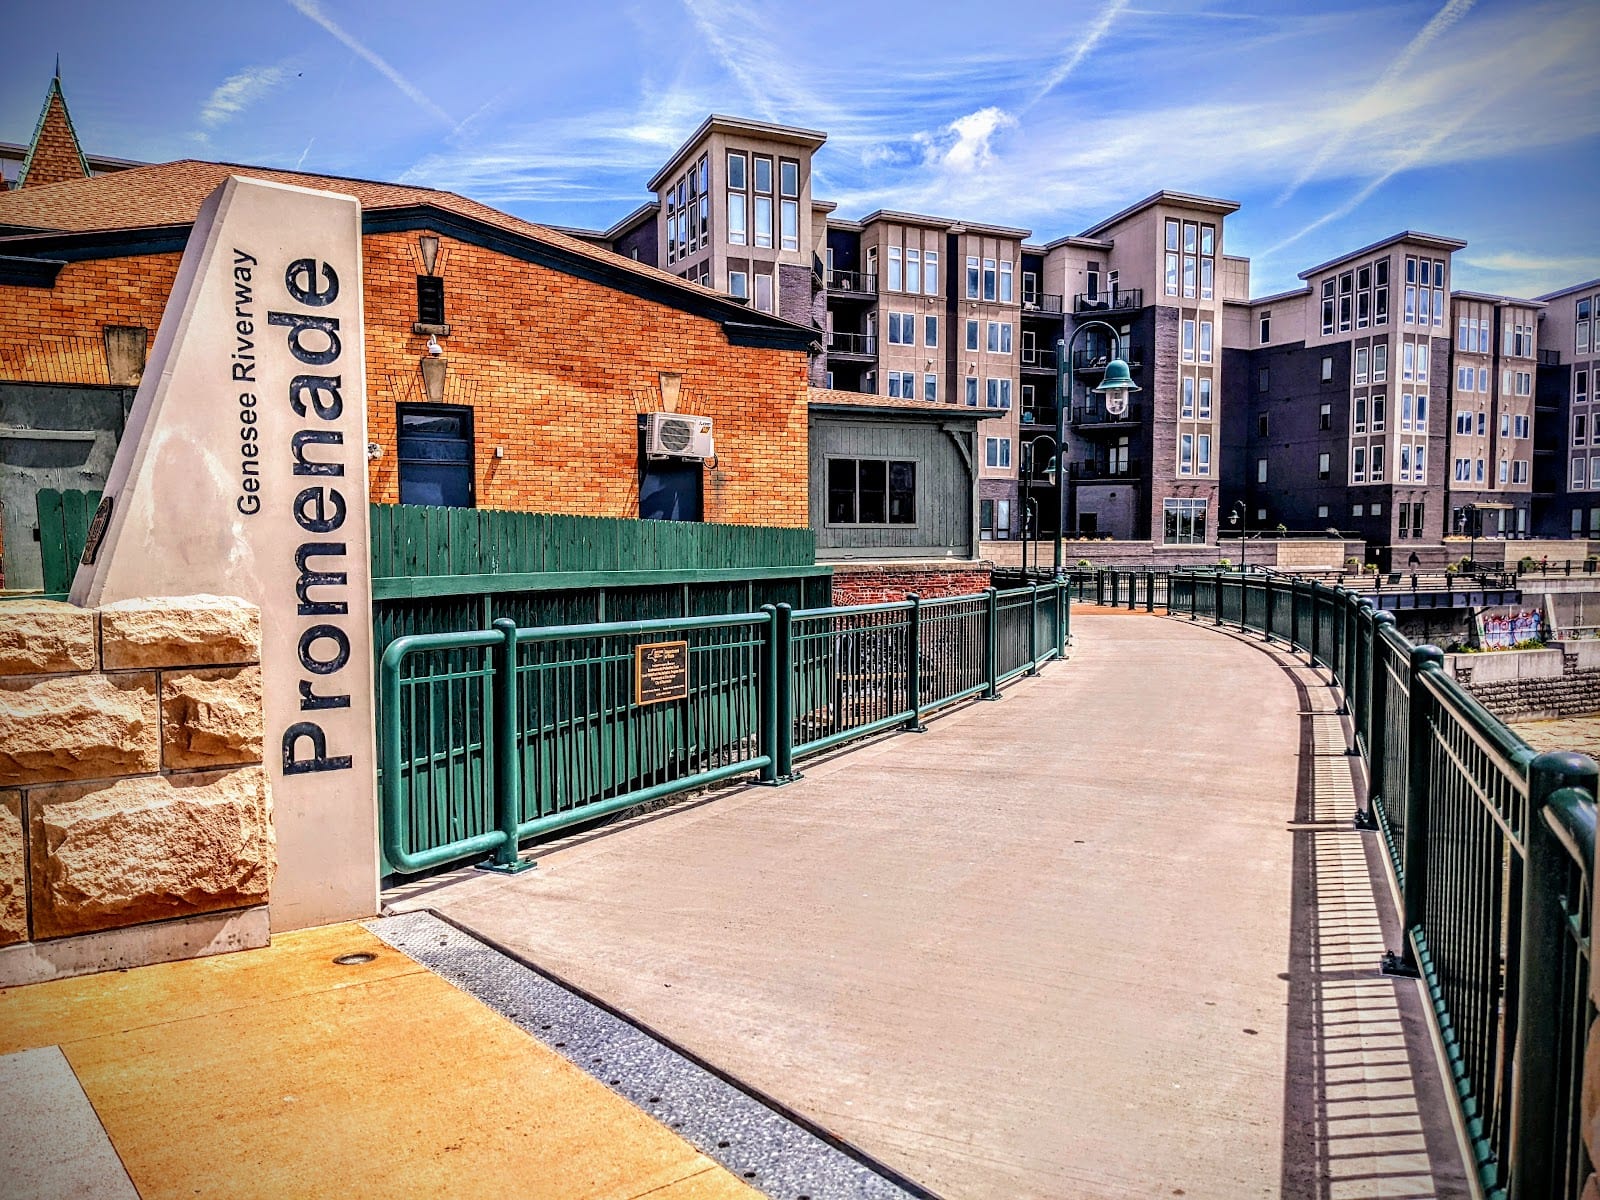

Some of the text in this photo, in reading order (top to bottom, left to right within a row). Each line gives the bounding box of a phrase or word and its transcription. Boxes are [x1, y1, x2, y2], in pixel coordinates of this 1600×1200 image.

[231, 247, 261, 516] Genesee Riverway
[267, 258, 353, 777] Promenade
